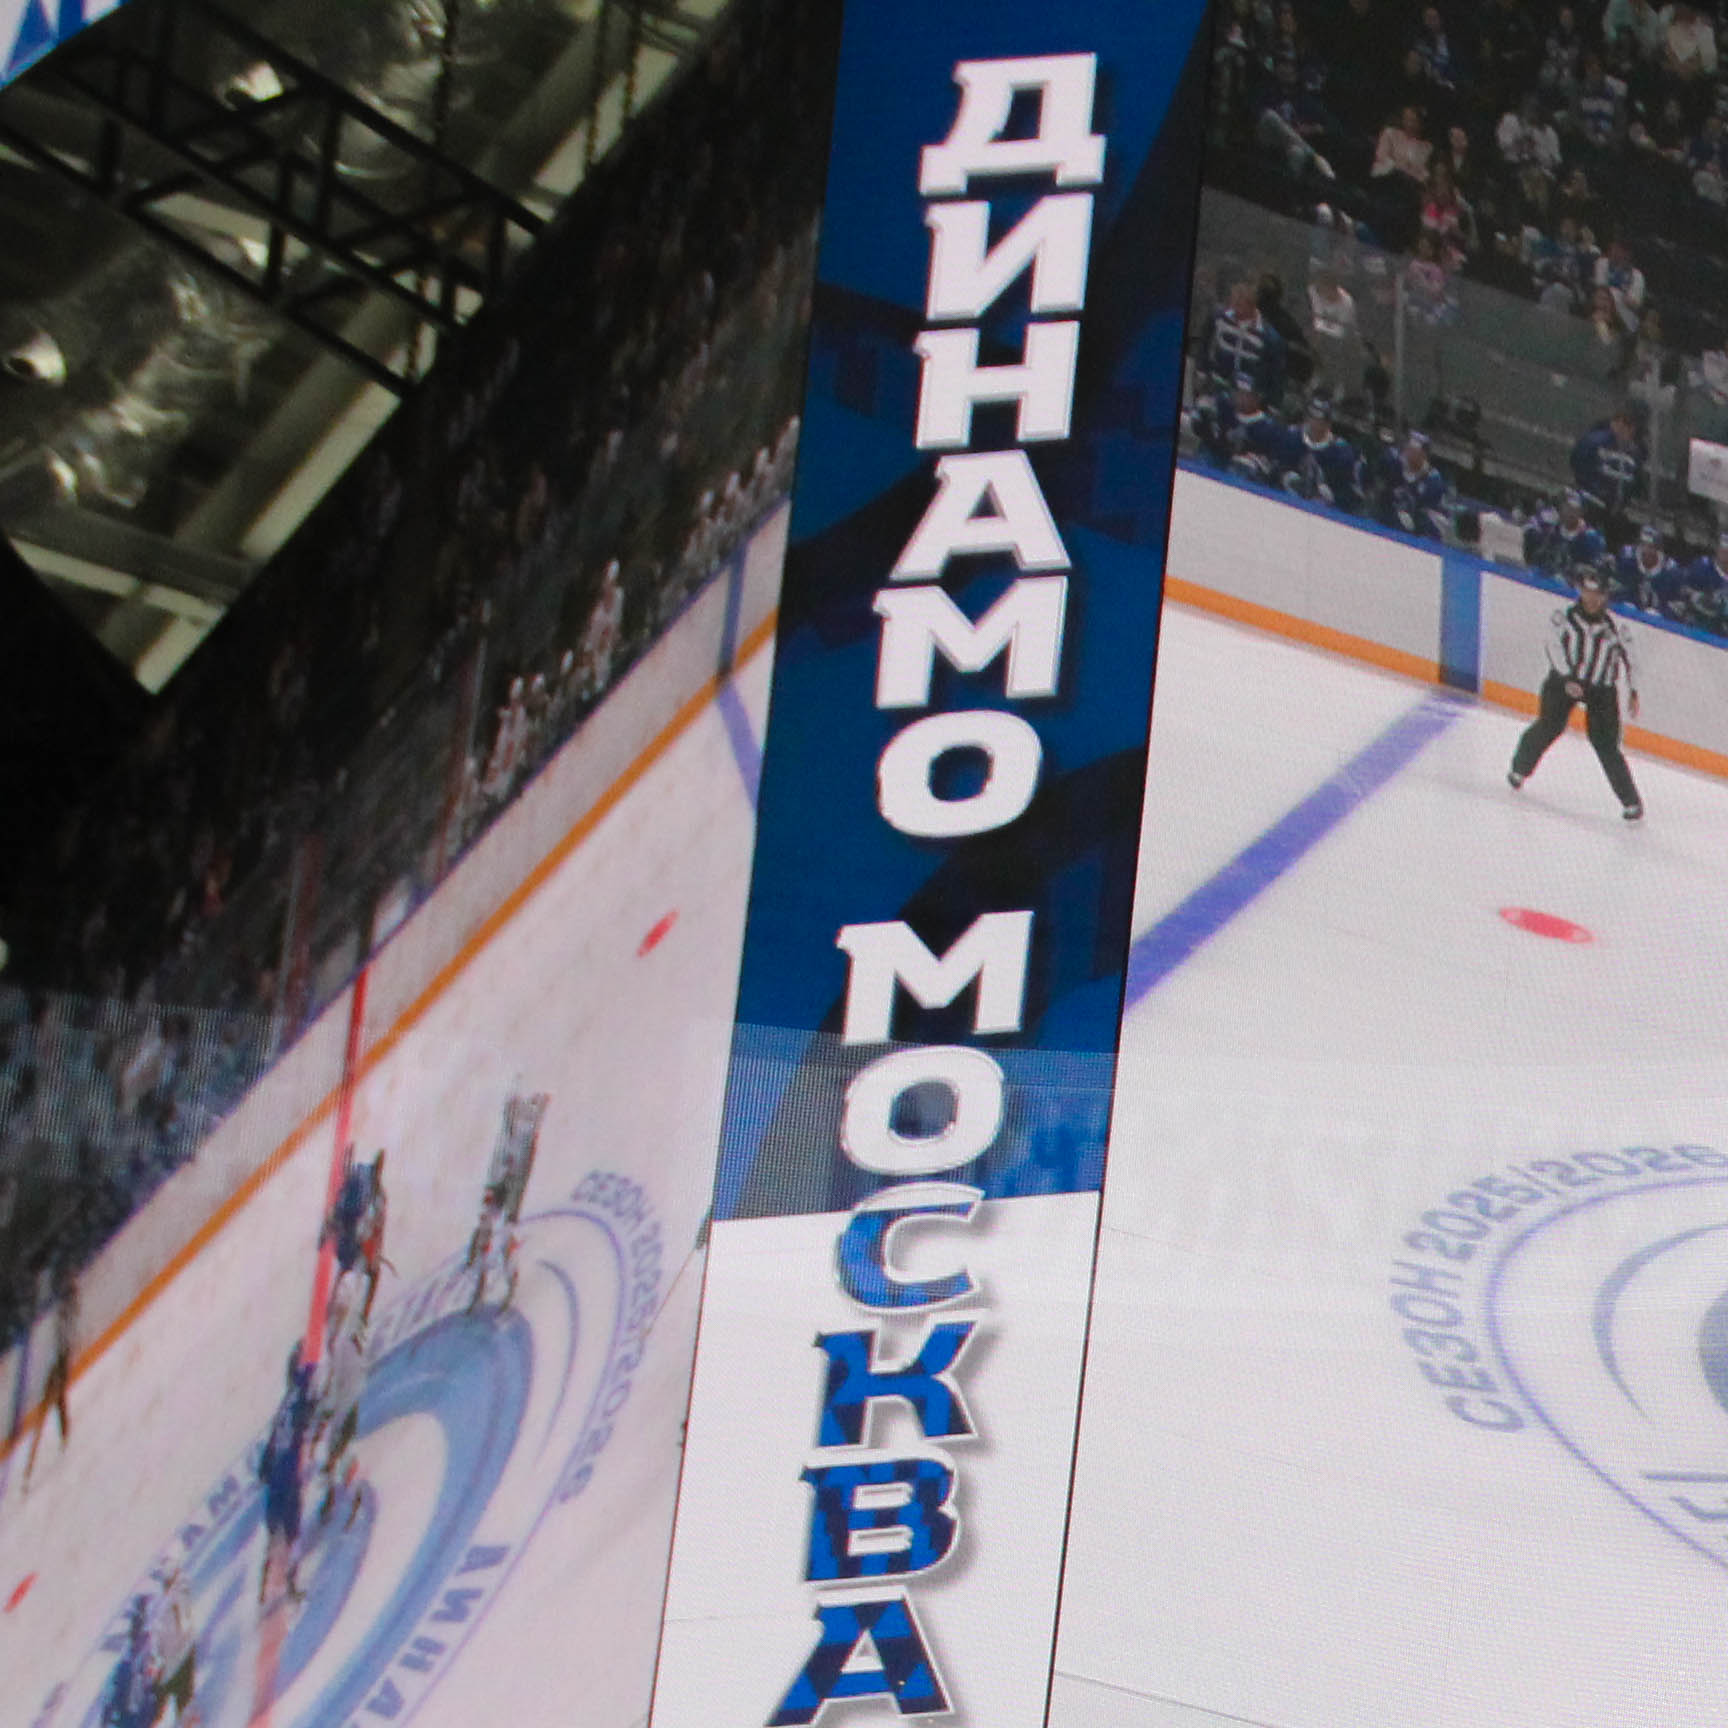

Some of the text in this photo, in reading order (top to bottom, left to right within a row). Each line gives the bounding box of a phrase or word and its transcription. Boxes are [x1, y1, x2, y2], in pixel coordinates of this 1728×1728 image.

[763, 52, 1106, 1728] ДИНАМО МОСКВА
[1389, 1259, 1525, 1432] СЕЗОН
